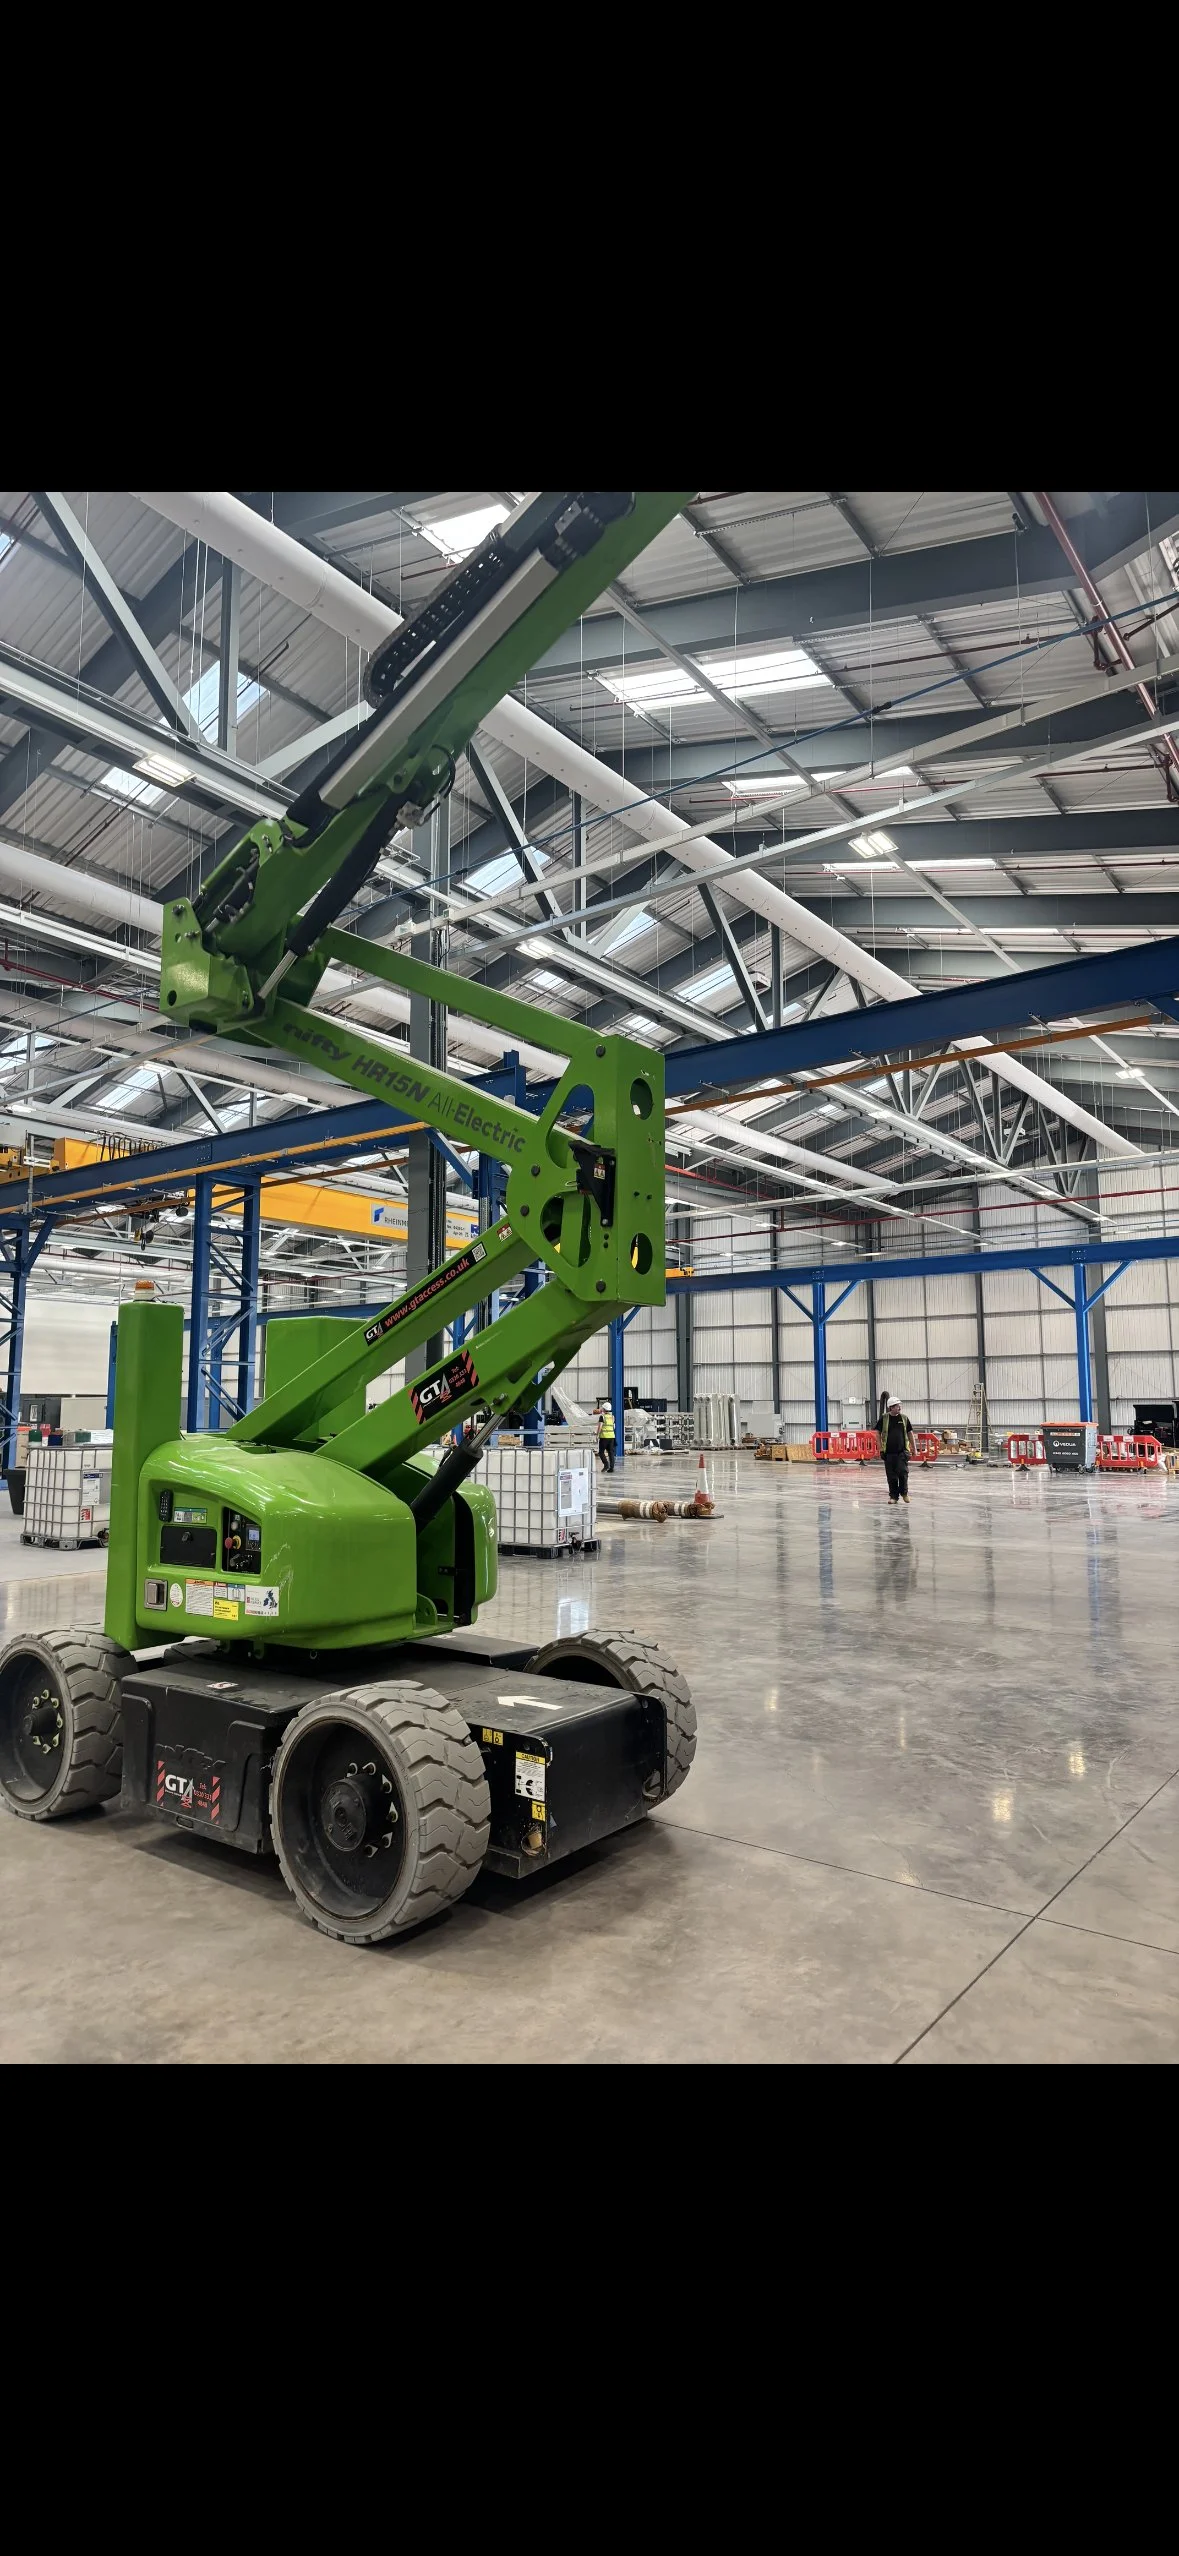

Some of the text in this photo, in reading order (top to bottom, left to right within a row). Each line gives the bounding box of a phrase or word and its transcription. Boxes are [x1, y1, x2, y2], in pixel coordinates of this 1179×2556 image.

[352, 1055, 430, 1103] HR15N
[427, 1091, 526, 1153] All-Electric
[384, 1258, 470, 1327] www.gtaccess.co.uk
